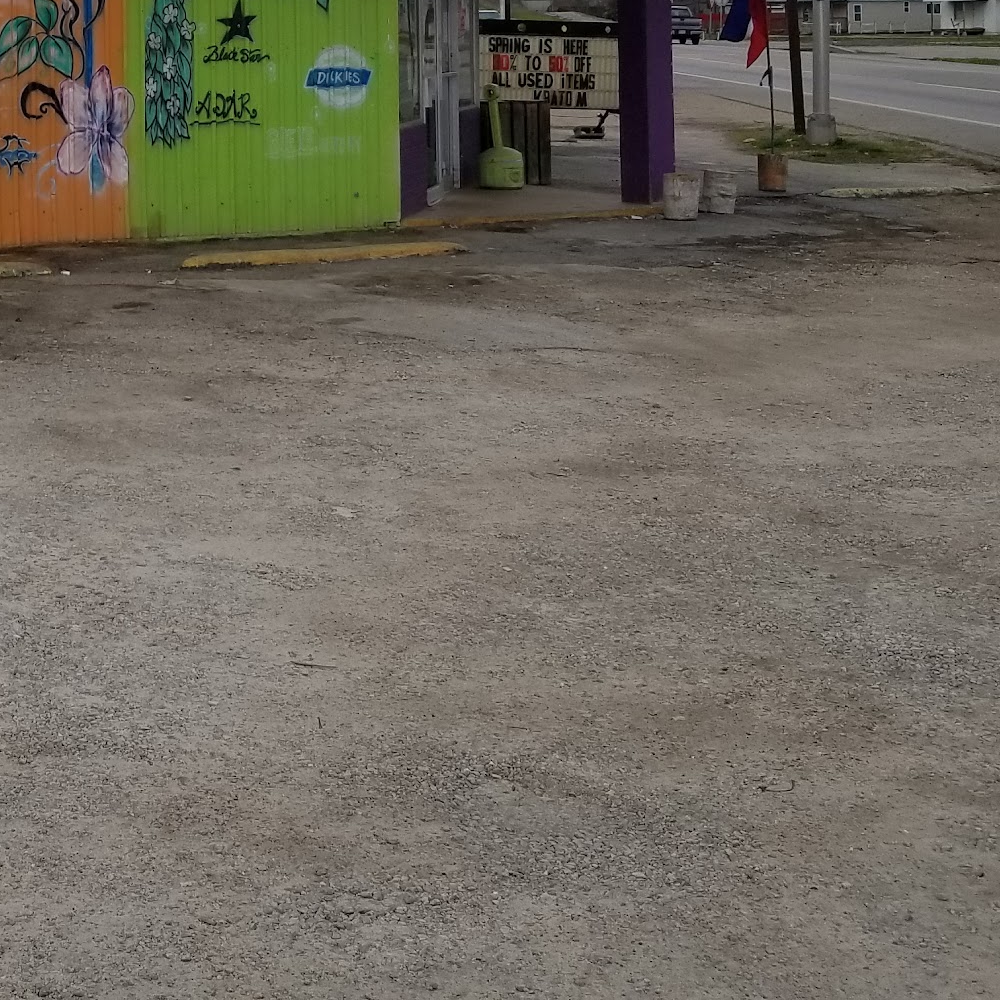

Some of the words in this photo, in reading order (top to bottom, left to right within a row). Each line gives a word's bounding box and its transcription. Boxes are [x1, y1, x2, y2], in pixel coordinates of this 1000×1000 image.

[488, 36, 531, 53] SPRING
[538, 38, 553, 54] IS
[563, 39, 589, 55] HERE
[524, 55, 541, 71] TO
[574, 56, 592, 73] OFF
[316, 70, 361, 85] DICKIES
[491, 72, 511, 88] ALL
[517, 72, 554, 89] USED
